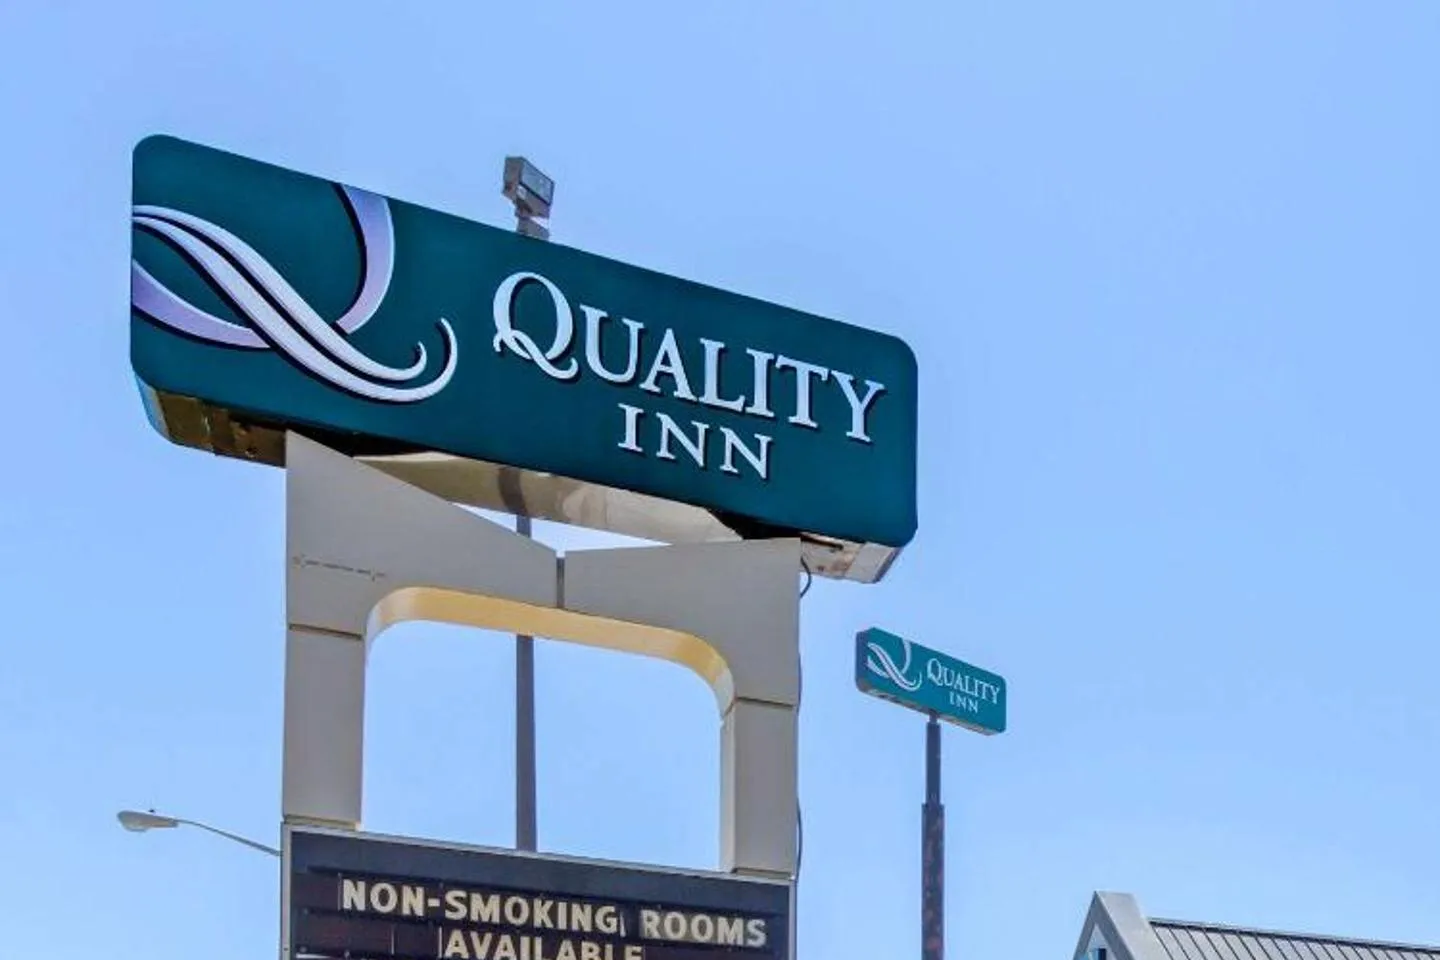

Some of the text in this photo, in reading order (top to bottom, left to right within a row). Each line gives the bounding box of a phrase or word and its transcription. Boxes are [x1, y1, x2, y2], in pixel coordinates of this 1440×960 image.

[492, 271, 886, 444] QUALITY
[618, 402, 773, 480] INN
[927, 658, 1000, 705] QUALITY
[950, 691, 979, 714] INN
[342, 878, 767, 948] NON-SMOKING ROOMS
